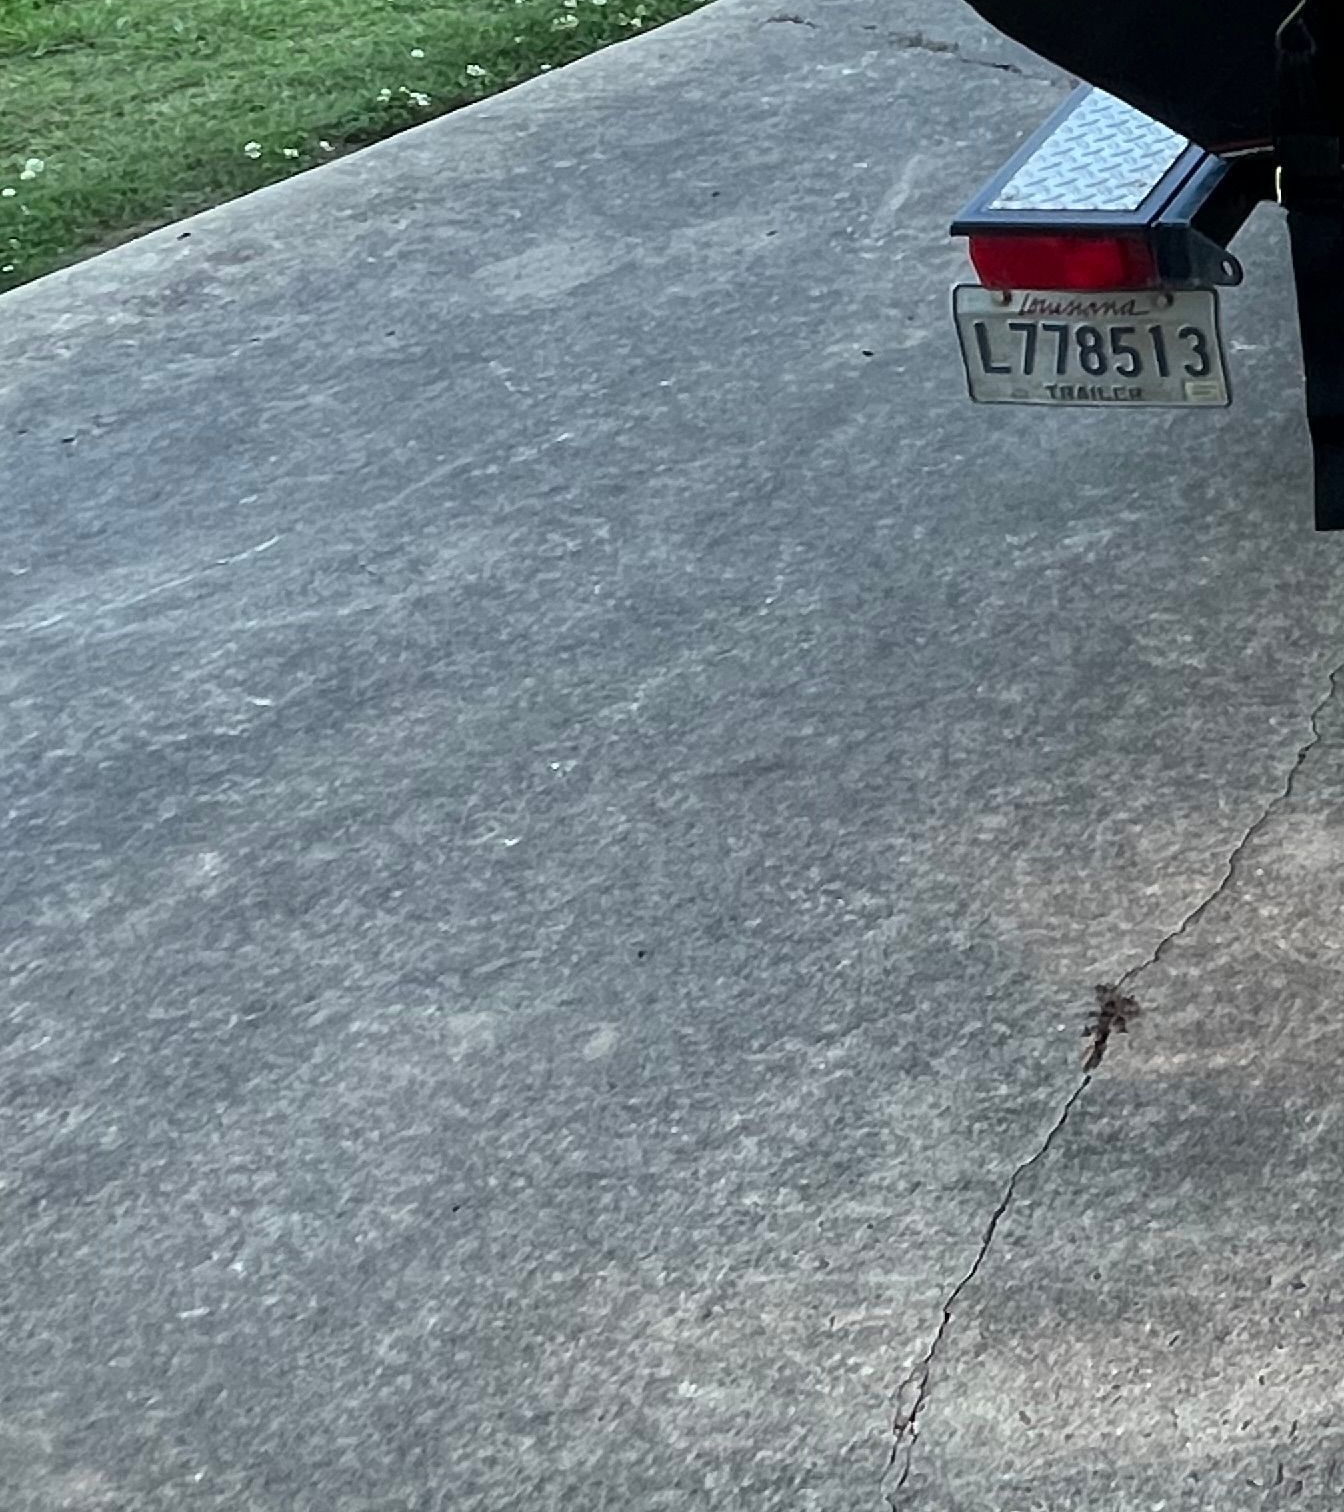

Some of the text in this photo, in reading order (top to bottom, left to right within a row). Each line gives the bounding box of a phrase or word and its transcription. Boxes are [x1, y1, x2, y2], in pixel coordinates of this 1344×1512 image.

[1017, 292, 1149, 317] Louisiana
[973, 321, 1212, 378] L778513
[1043, 385, 1143, 400] TRAILER
